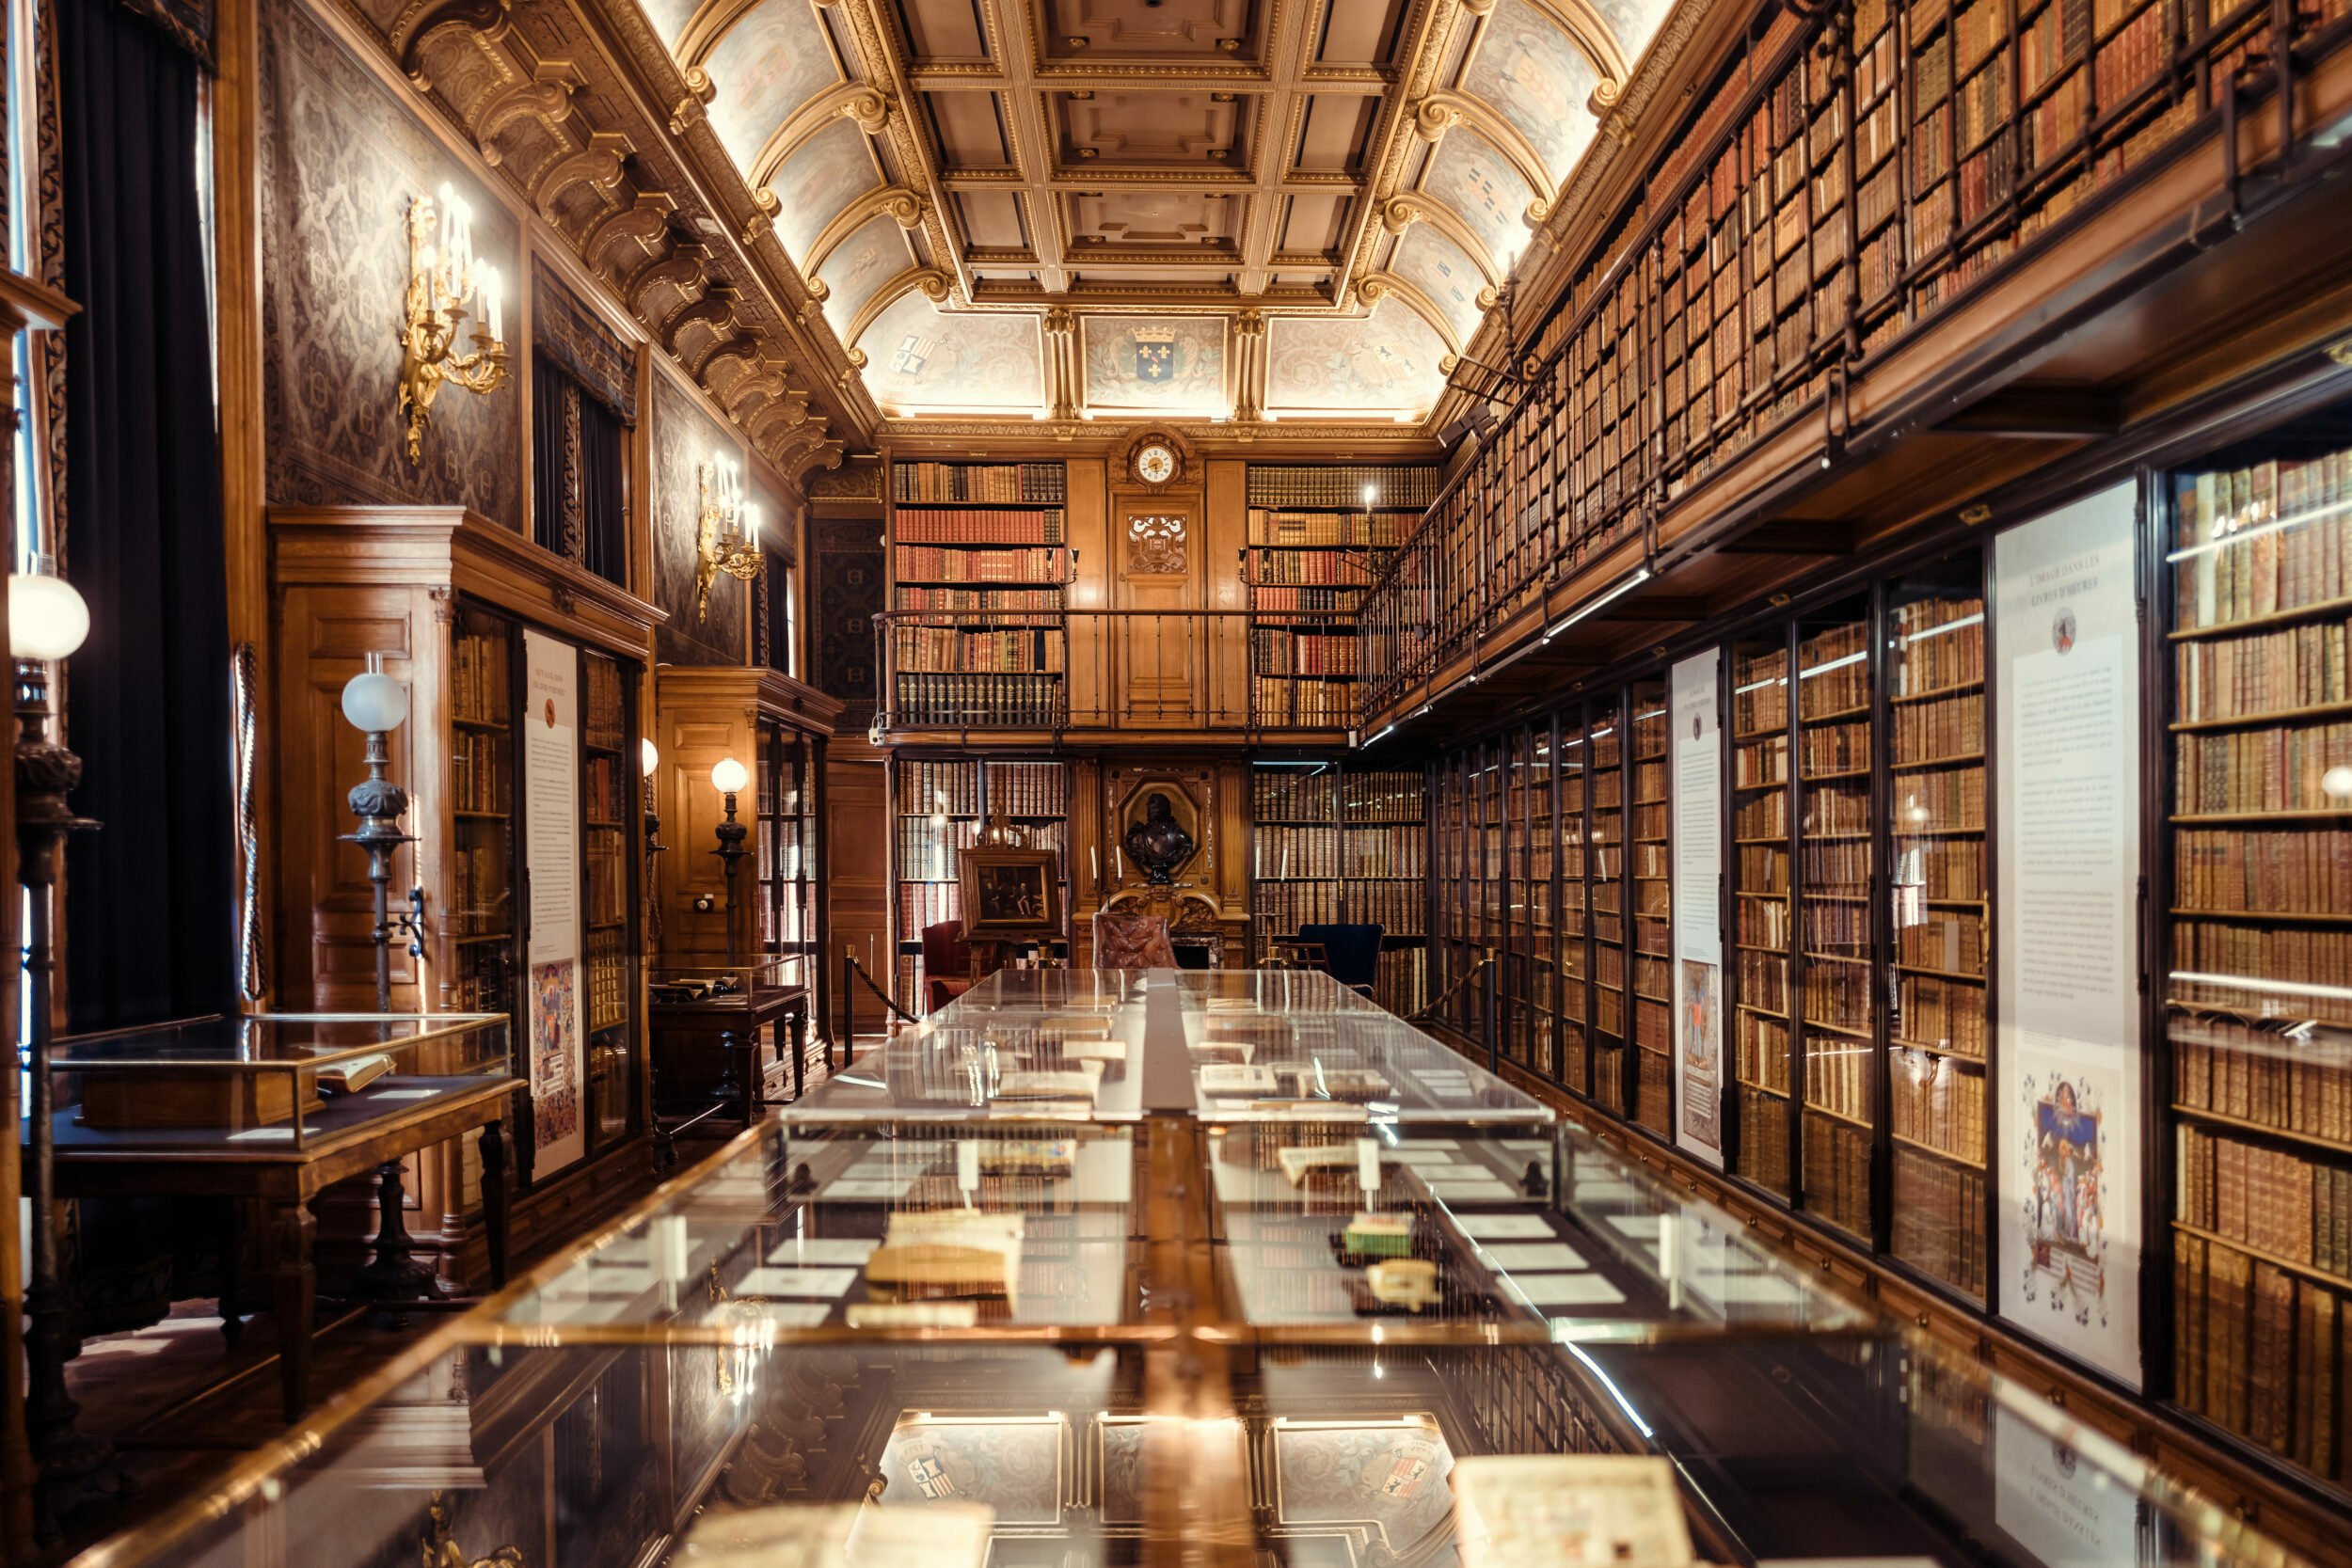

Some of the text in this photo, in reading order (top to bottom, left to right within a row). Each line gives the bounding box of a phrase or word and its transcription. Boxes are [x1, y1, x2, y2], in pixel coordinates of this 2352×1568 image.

[2061, 559, 2084, 576] DANS
[2084, 553, 2100, 569] LES
[2031, 576, 2099, 608] LIVRES D'HEURES
